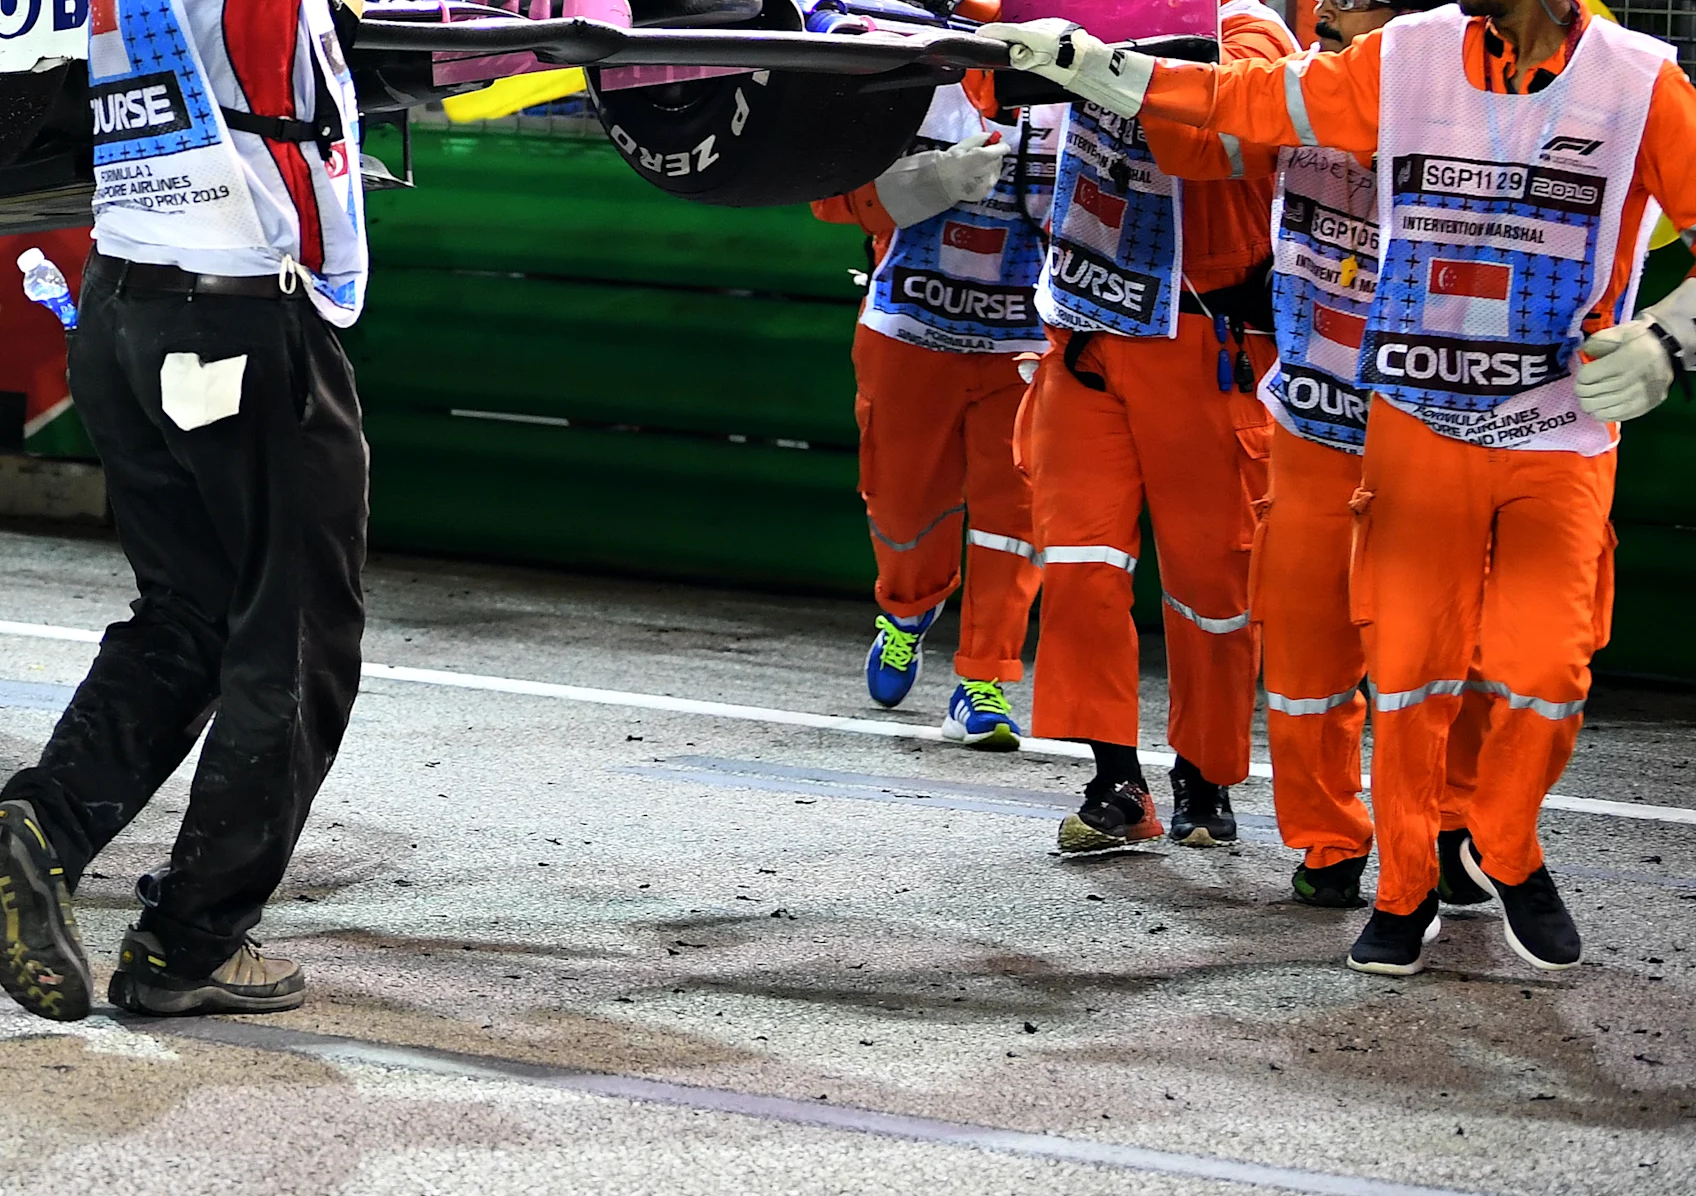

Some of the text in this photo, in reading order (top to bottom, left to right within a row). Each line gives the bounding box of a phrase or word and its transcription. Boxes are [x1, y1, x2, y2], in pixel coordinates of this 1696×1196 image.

[610, 86, 750, 176] P ZERO
[129, 175, 192, 195] AIRLINES
[156, 192, 189, 208] PRIX
[190, 185, 230, 203] 2019
[1529, 176, 1598, 205] 2019
[1403, 216, 1545, 244] INTERVENTION MARSHAL
[904, 275, 1028, 321] COURSE
[1376, 343, 1548, 386] COURSE
[1413, 406, 1486, 426] FORMULA
[1465, 407, 1540, 437] AIRLINES
[1499, 424, 1536, 443] PRIX
[1537, 411, 1577, 433] 2019
